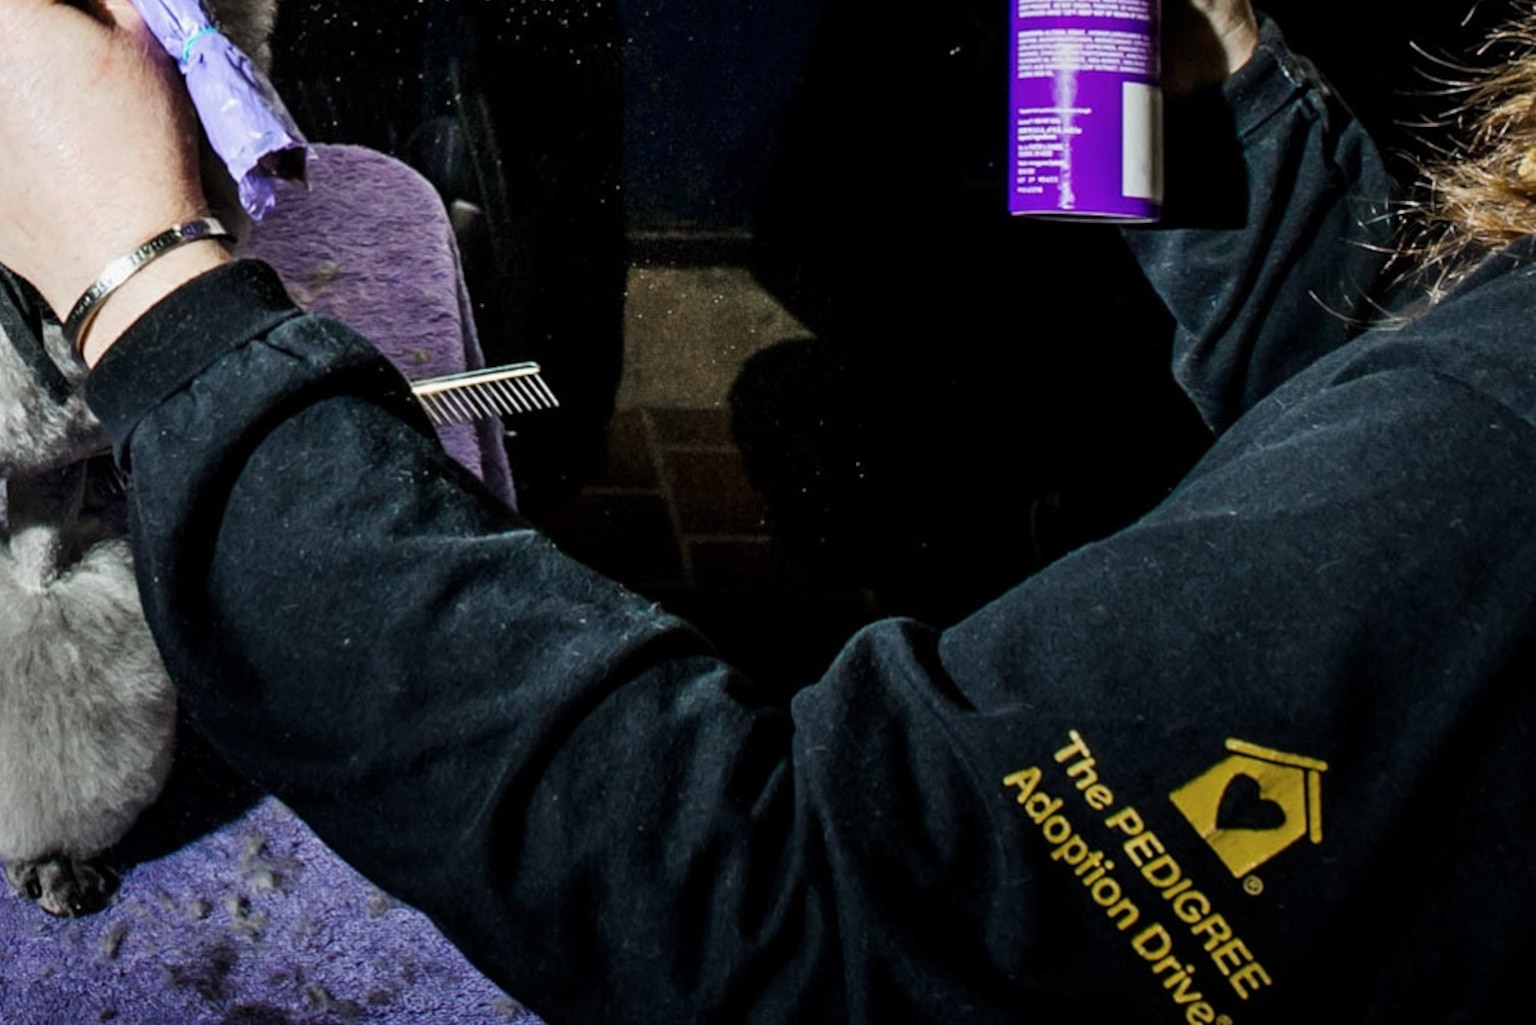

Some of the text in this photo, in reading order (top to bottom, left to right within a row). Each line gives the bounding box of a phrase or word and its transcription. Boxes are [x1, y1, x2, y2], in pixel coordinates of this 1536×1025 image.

[1003, 766, 1140, 931] Adoption
[1053, 730, 1273, 1000] The PEDIGREE
